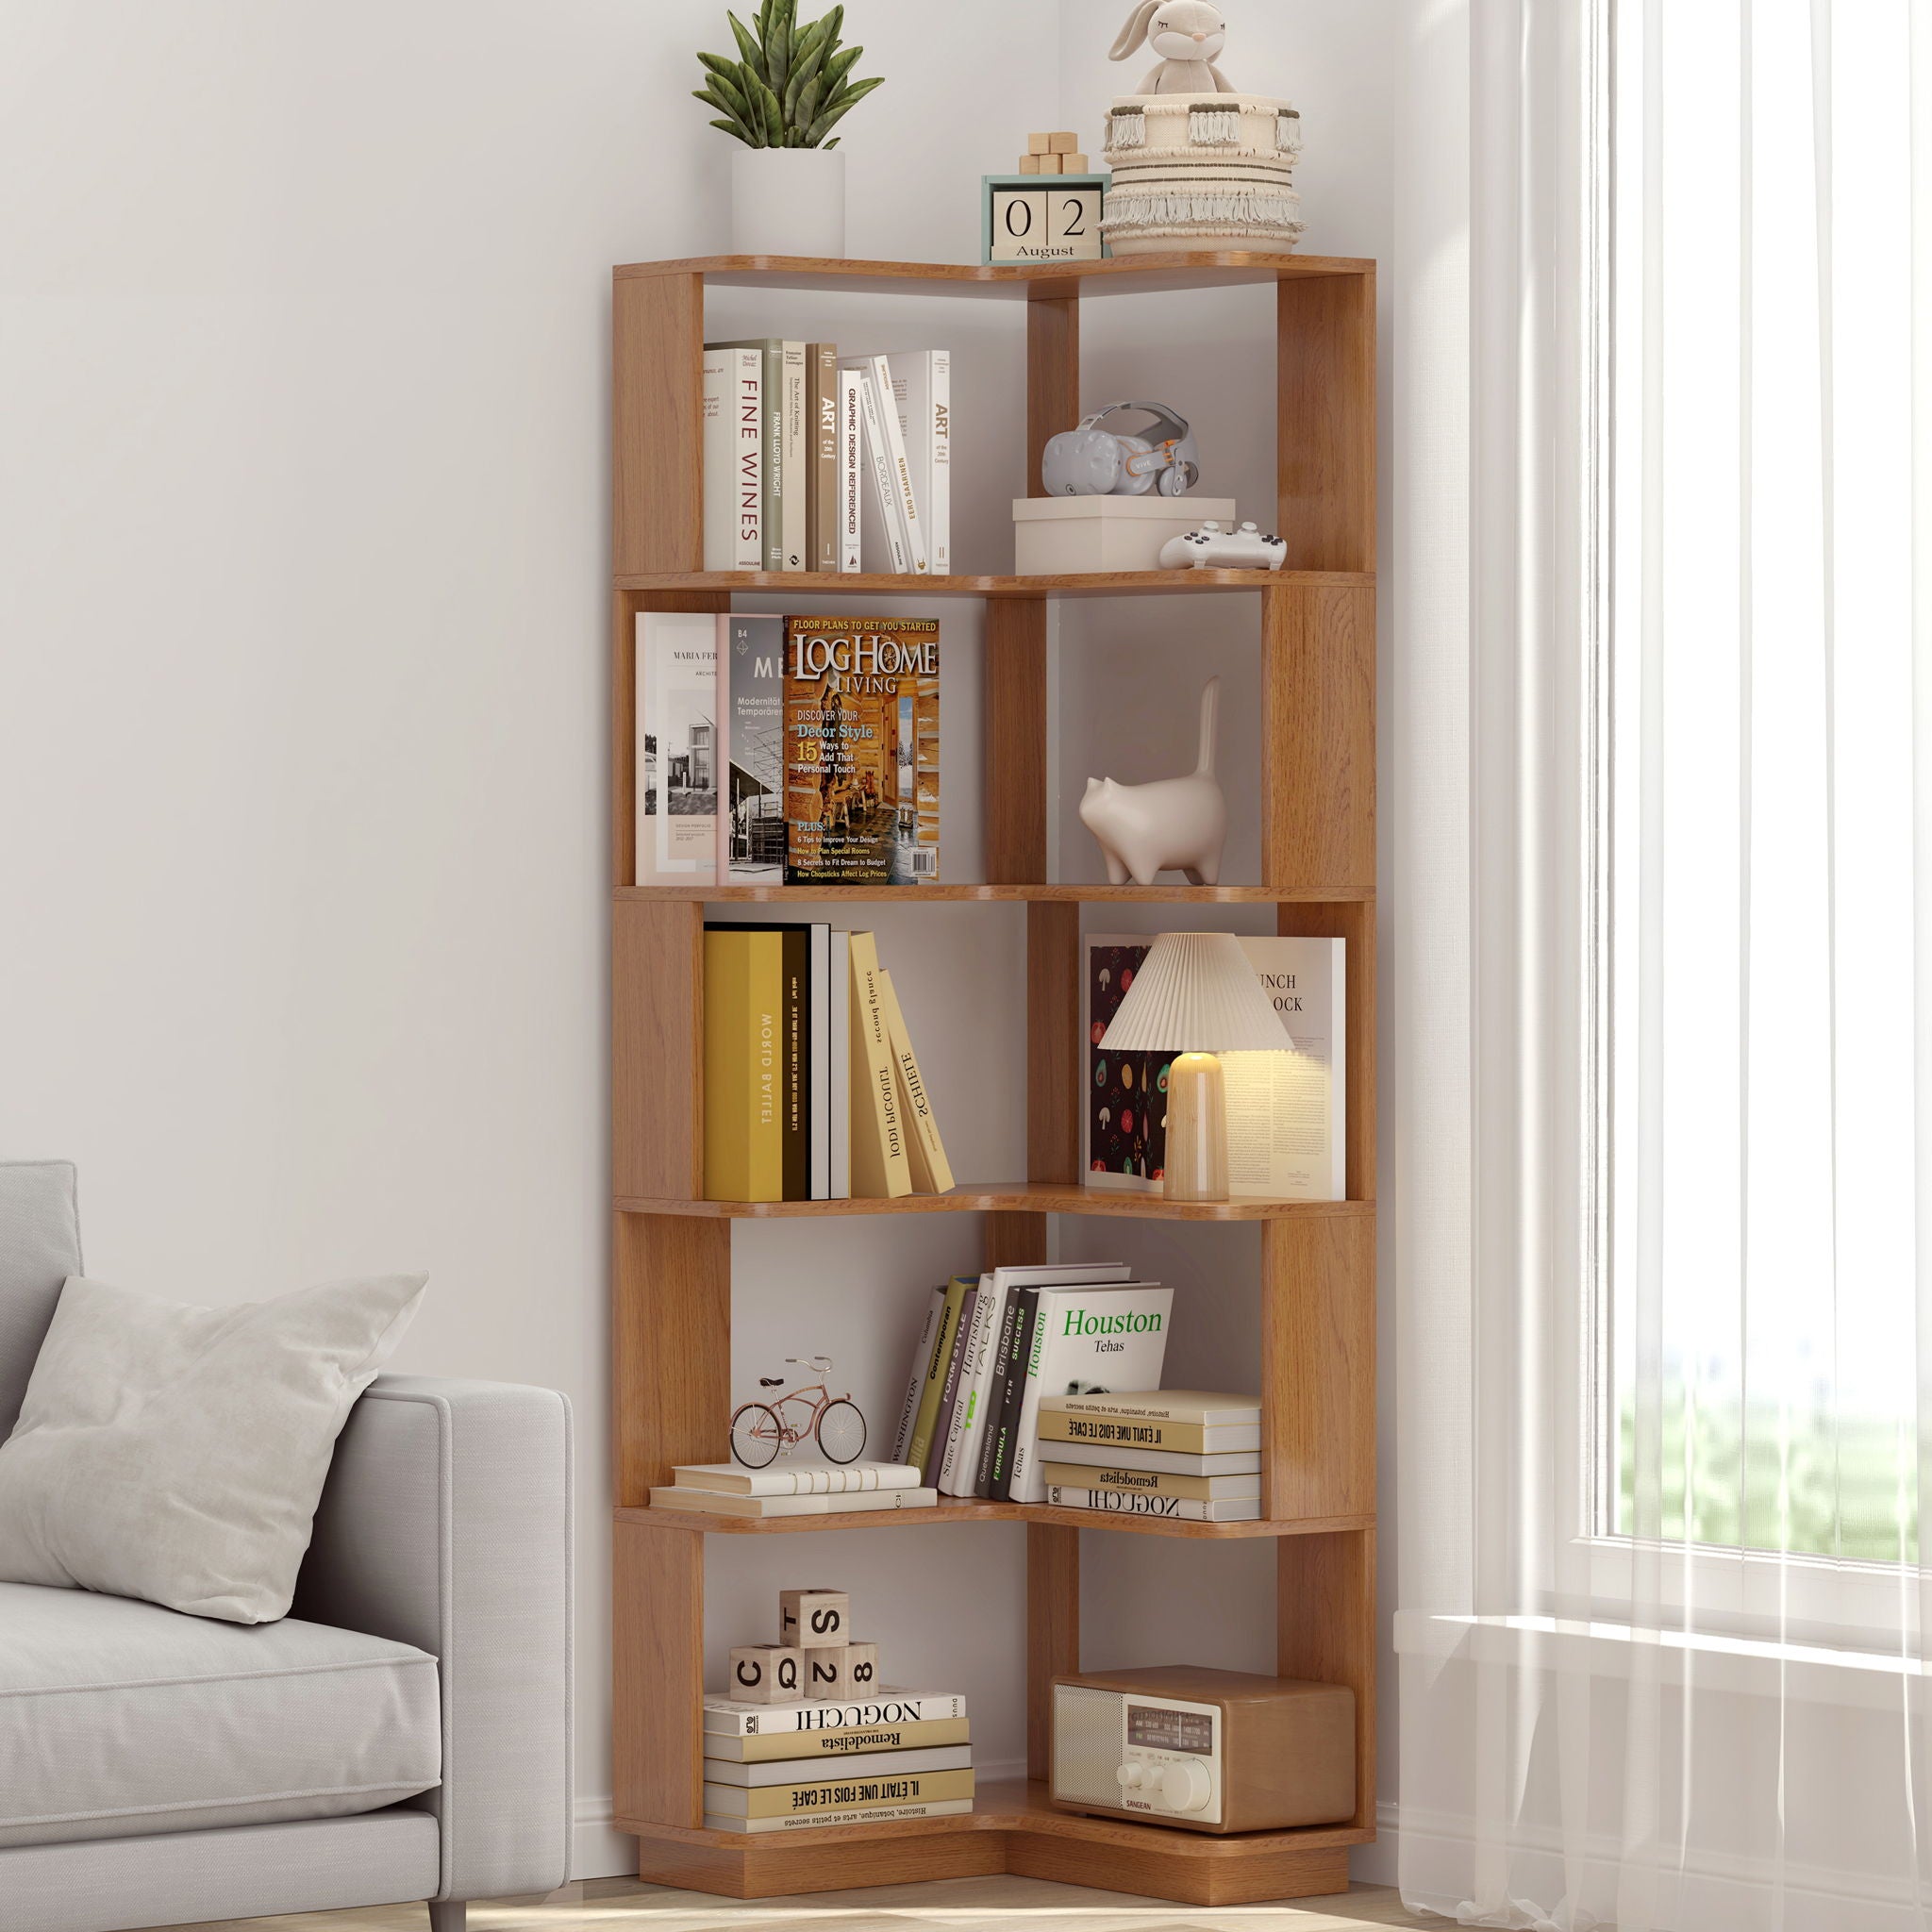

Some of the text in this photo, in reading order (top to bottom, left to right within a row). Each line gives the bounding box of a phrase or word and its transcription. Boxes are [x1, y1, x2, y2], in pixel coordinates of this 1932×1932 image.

[1006, 199, 1086, 237] 0 2
[1016, 245, 1075, 259] August
[822, 397, 835, 434] ART
[936, 404, 948, 439] ART
[741, 380, 758, 541] FINE WINES
[773, 412, 781, 497] FRANK LLOYD WRIGHT
[876, 457, 892, 508] BORDEAUX
[898, 458, 916, 520] EERO SAARINEN
[794, 620, 820, 629] FLOOR
[823, 621, 849, 630] PLANS
[852, 621, 862, 630] TO
[864, 621, 880, 630] GET
[883, 622, 898, 631] YOU
[901, 622, 936, 632] STARTED
[674, 651, 700, 660] MARIA
[837, 676, 897, 694] LIVING
[738, 697, 781, 706] Modernität
[798, 710, 858, 721] DISCOVER YOUR
[797, 724, 874, 741] Decor Style
[797, 741, 849, 761] 15 Ways to
[820, 752, 854, 762] Add That
[798, 764, 856, 773] Personal Touch
[797, 822, 826, 832] PLUS:
[860, 836, 878, 844] Design
[963, 1293, 989, 1376] Harrisburg
[1062, 1309, 1162, 1336] Houston
[996, 1305, 1015, 1376] Brisbane
[1028, 1312, 1047, 1378] Houston
[1094, 1340, 1125, 1353] Tehas
[943, 1313, 967, 1403] FORM STYLE
[992, 1308, 1025, 1481] FORMULA FOR SUCCESS
[893, 1378, 918, 1462] WASHINGTON
[943, 1399, 964, 1477] State Capital
[979, 1424, 994, 1482] Queensland
[1013, 1447, 1025, 1479] Tehas
[811, 1609, 841, 1634] S
[737, 1660, 762, 1687] C
[778, 1657, 797, 1690] Q
[812, 1661, 837, 1684] 2
[853, 1661, 874, 1683] 8
[795, 1701, 923, 1731] NOGUCHI
[822, 1732, 901, 1750] Remodelista
[792, 1780, 919, 1810] IL ÉTAIT UNE FOIS LE CAFÉ
[1126, 1799, 1151, 1810] SANGEAN
[784, 1818, 810, 1827] secrets
[811, 1815, 832, 1824] petits
[859, 1810, 895, 1819] botanique,
[897, 1807, 926, 1815] Histoire,
